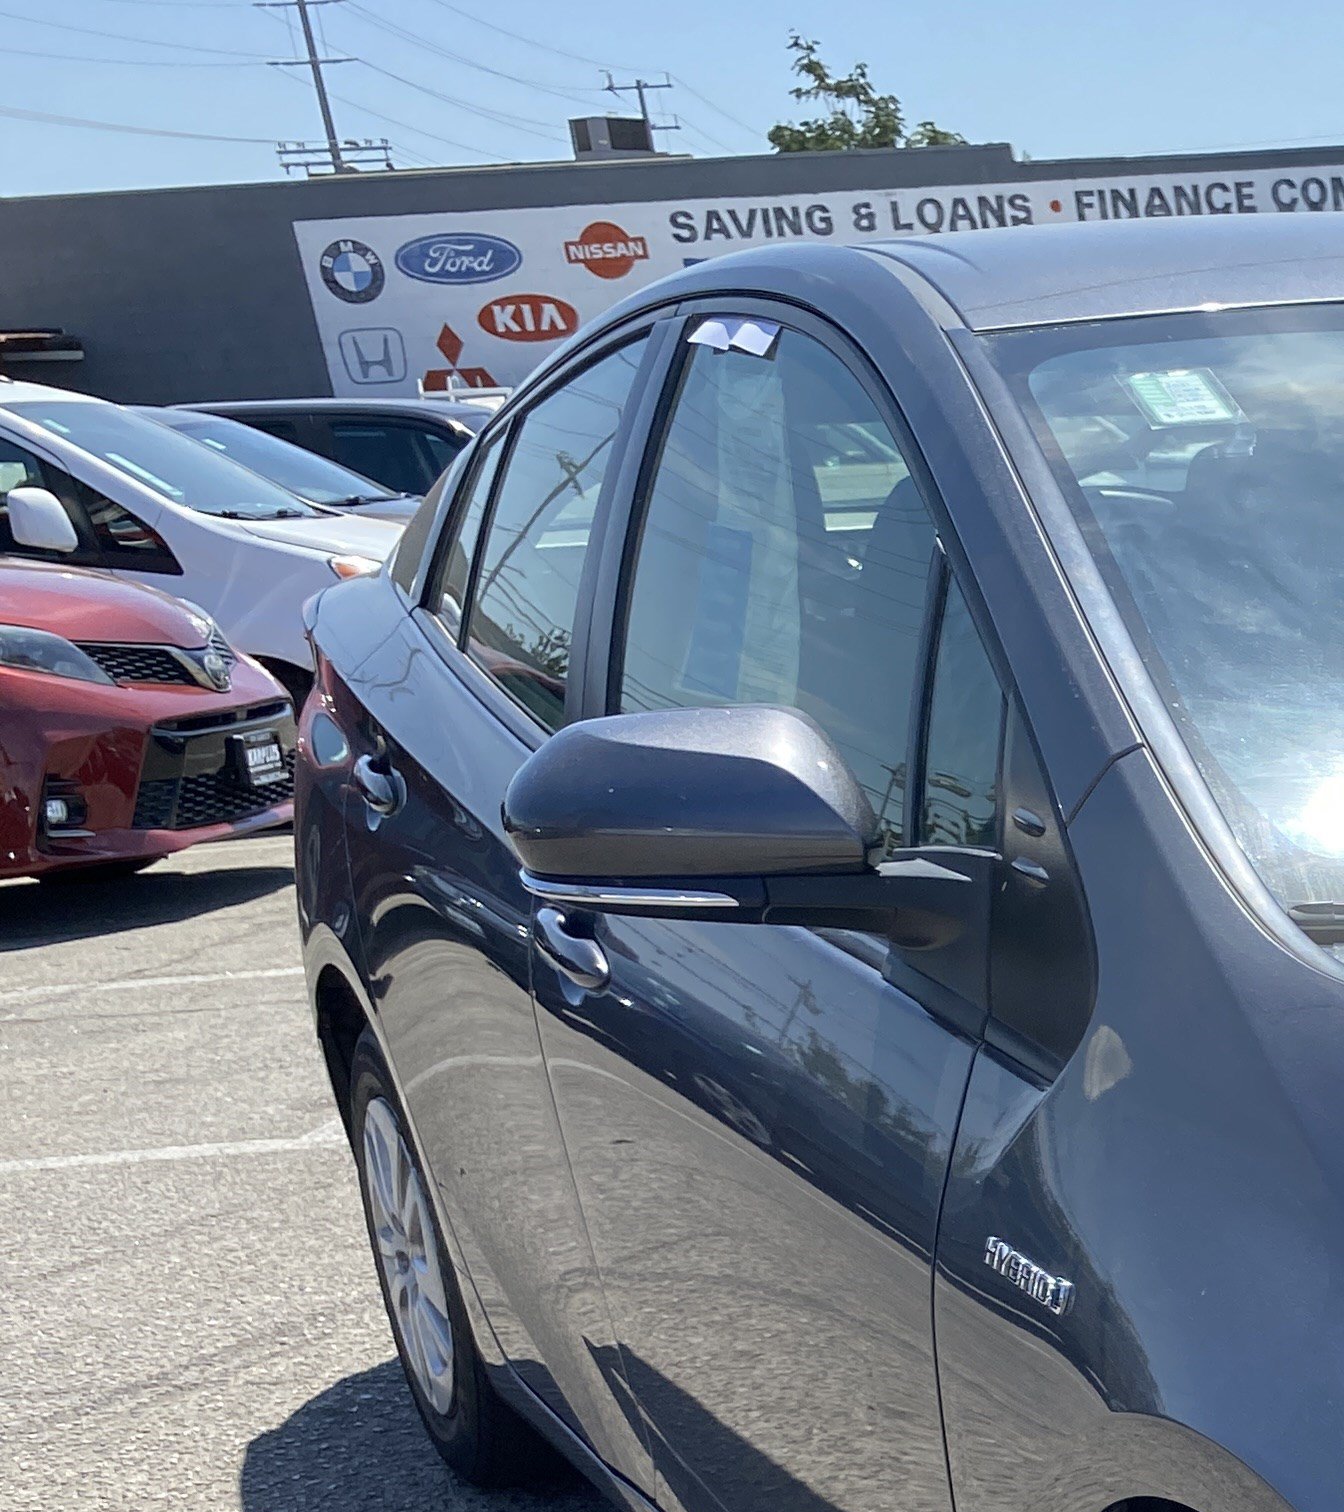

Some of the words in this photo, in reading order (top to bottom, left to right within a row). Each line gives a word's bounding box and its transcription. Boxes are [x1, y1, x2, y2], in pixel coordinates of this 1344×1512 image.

[668, 203, 835, 243] SAVING
[852, 201, 877, 233] &
[890, 193, 1034, 234] LOANS
[1074, 180, 1258, 222] FINANCE
[423, 243, 495, 275] Ford
[567, 240, 645, 261] NISSAN
[491, 303, 569, 333] KIA
